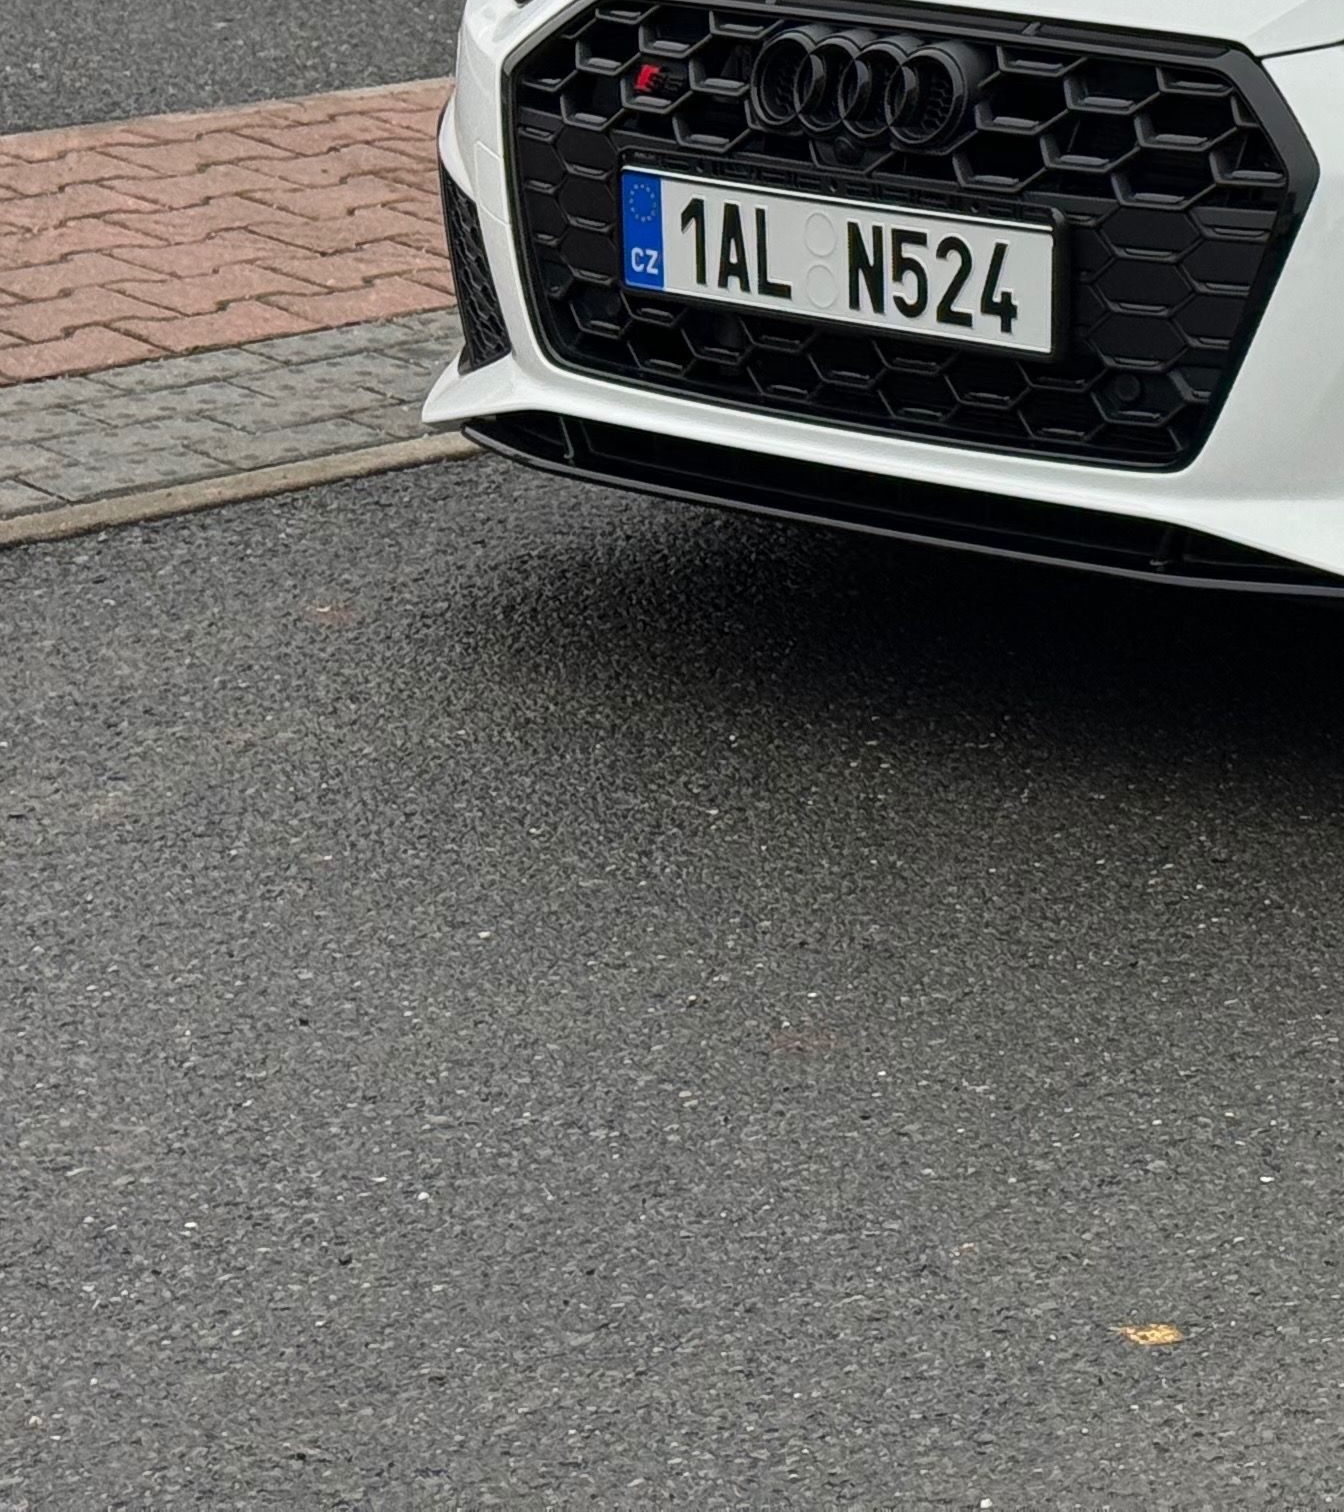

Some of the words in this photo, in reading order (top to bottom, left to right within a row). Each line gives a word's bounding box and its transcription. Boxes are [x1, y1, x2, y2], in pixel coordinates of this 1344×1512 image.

[631, 248, 659, 275] CZ
[681, 198, 792, 299] 1AL
[846, 220, 1018, 334] N524
